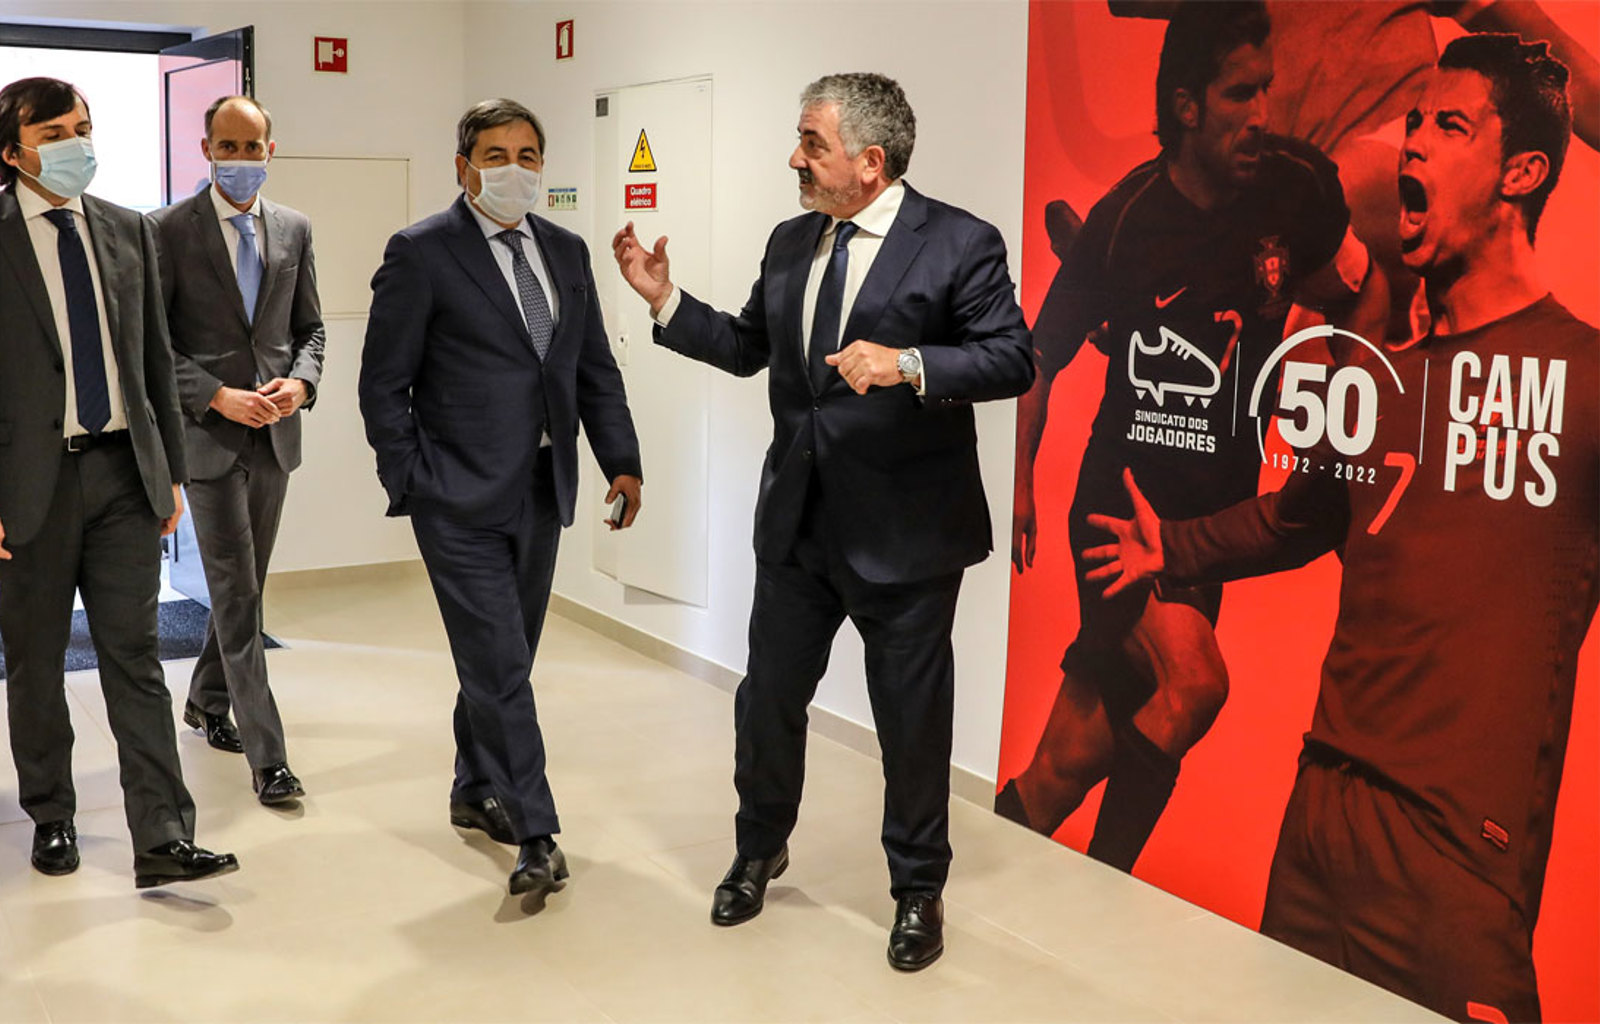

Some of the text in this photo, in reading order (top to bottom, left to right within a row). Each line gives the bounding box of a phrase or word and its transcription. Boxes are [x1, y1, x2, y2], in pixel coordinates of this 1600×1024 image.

[630, 186, 652, 196] Quadro
[1135, 409, 1209, 431] SINDICATO DOS
[1276, 360, 1379, 456] 50
[1448, 350, 1568, 434] CAM
[1126, 424, 1216, 454] JOGADORES
[1443, 421, 1561, 508] PUS
[1272, 452, 1310, 474] 1972
[1334, 462, 1377, 485] 2022
[1367, 452, 1416, 535] 7
